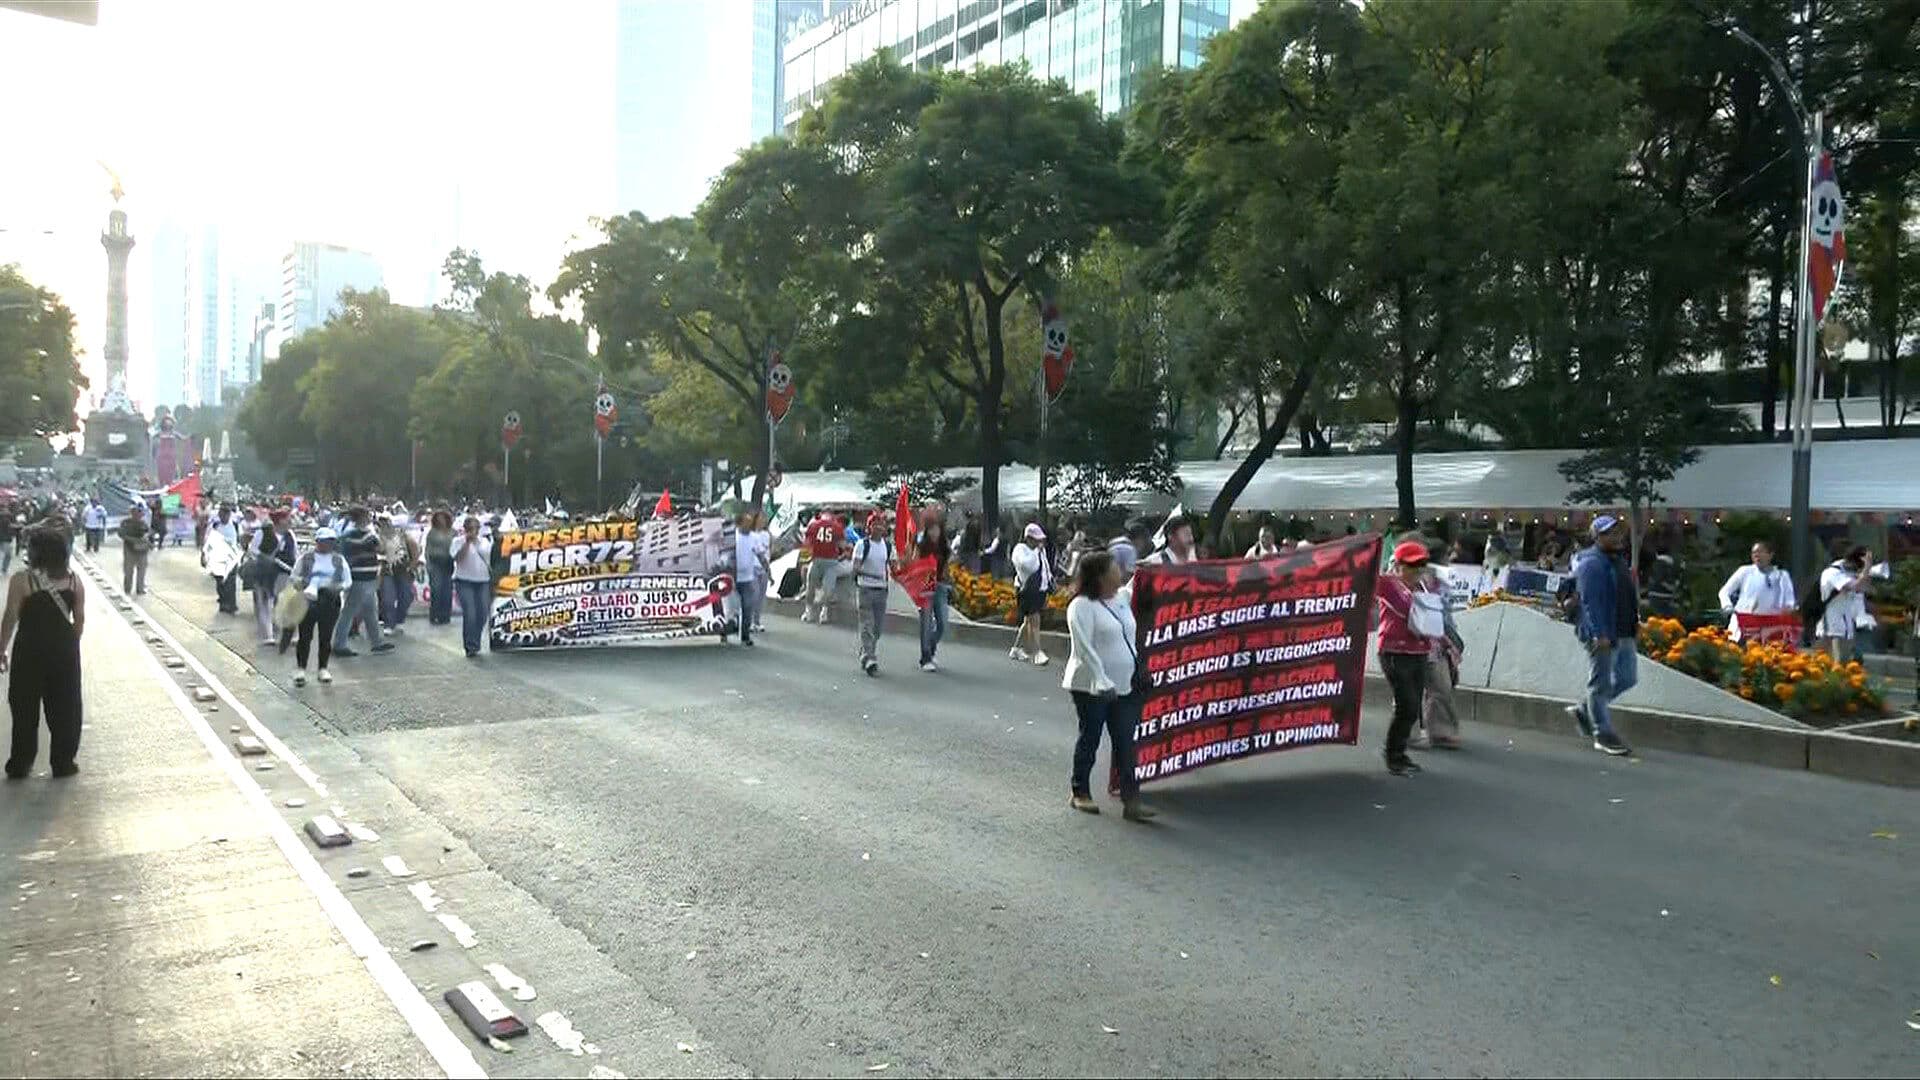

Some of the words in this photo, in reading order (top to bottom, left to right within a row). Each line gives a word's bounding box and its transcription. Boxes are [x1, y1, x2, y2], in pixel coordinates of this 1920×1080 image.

[501, 522, 637, 557] PRESENTE
[816, 526, 833, 543] 45
[510, 541, 634, 575] HGR72
[530, 581, 595, 601] GREMIO
[580, 593, 639, 609] SALARIO
[643, 591, 688, 604] JUSTO
[576, 607, 636, 622] RETIRO
[640, 604, 692, 617] DIGNO
[1177, 611, 1217, 637] BASE
[1220, 603, 1267, 626] SIGUE
[1270, 601, 1290, 617] AL
[1294, 593, 1357, 615] FRENTE!
[1167, 654, 1229, 683] SILENCIO
[1232, 649, 1251, 667] ES
[1255, 636, 1351, 664] VERGONZOSO!
[1160, 754, 1184, 775] ME
[1186, 736, 1250, 766] IMPONES
[1253, 732, 1273, 749] TU
